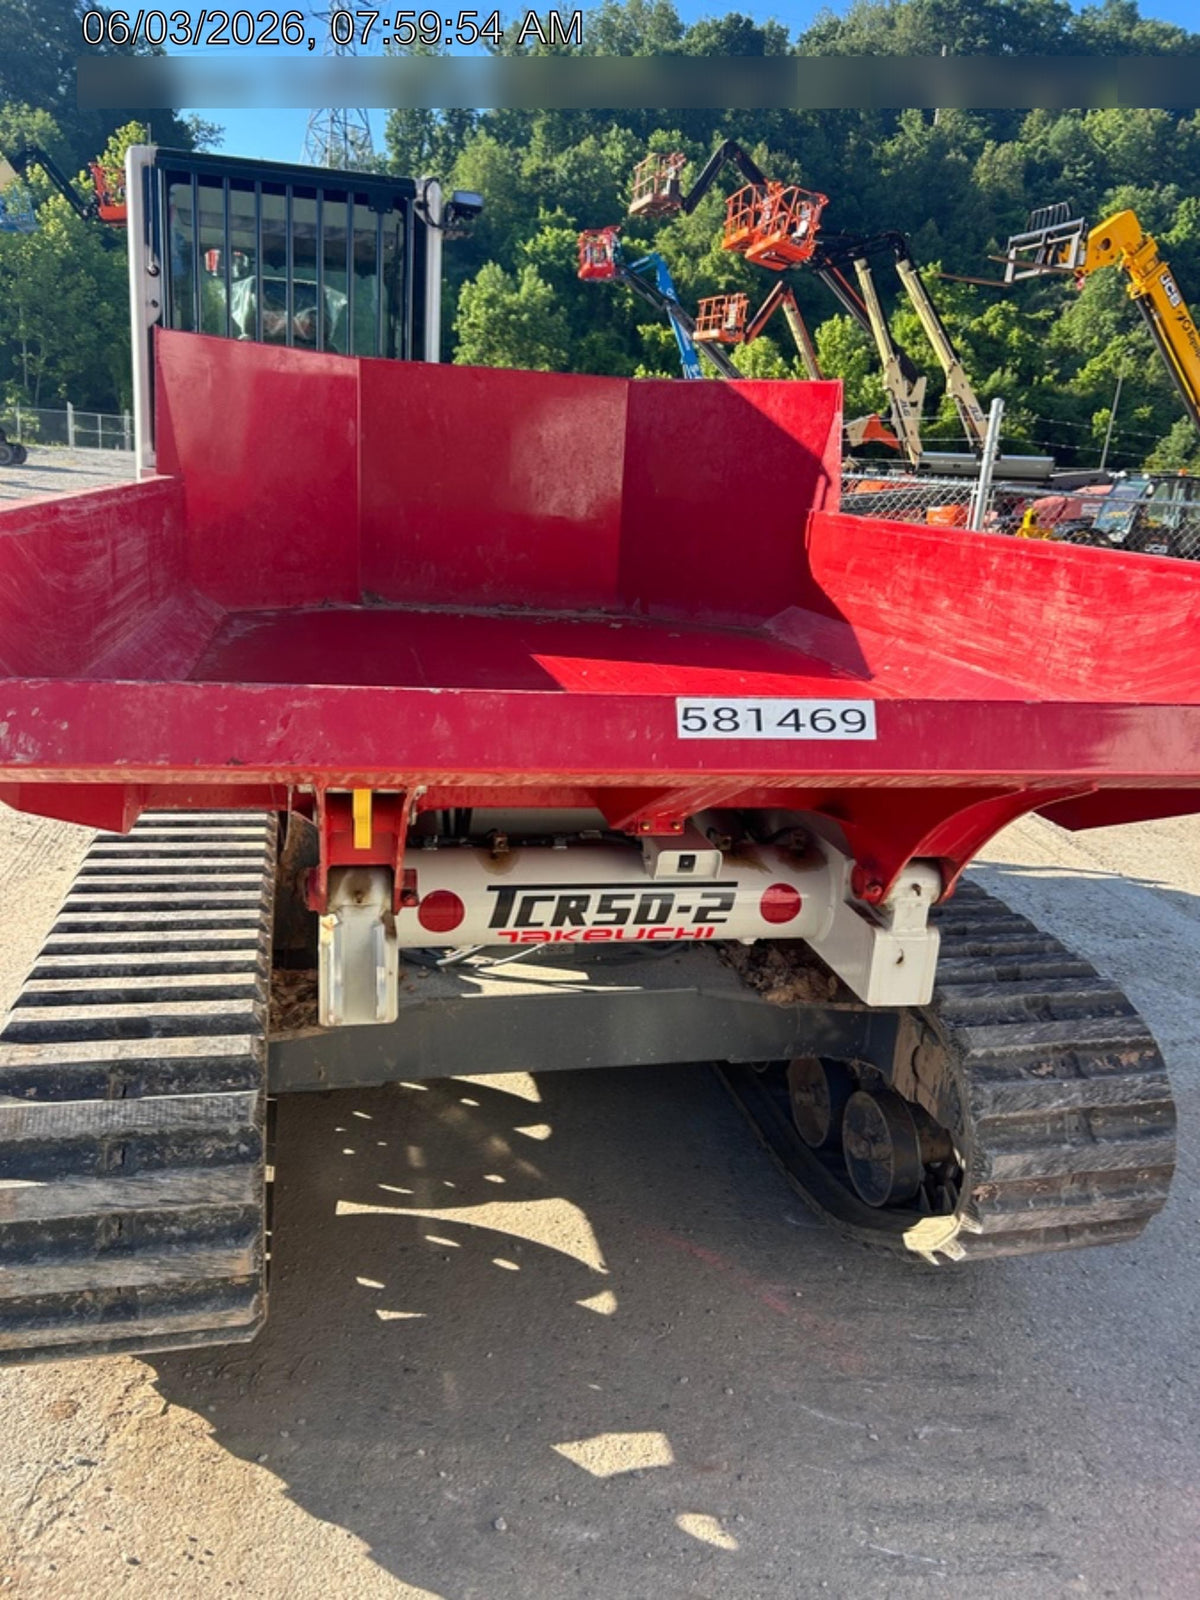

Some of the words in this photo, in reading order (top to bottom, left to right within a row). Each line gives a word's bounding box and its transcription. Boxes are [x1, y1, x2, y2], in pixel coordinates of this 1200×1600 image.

[1160, 273, 1182, 307] JCB
[681, 706, 867, 734] 581469
[486, 881, 739, 929] TCR50-2
